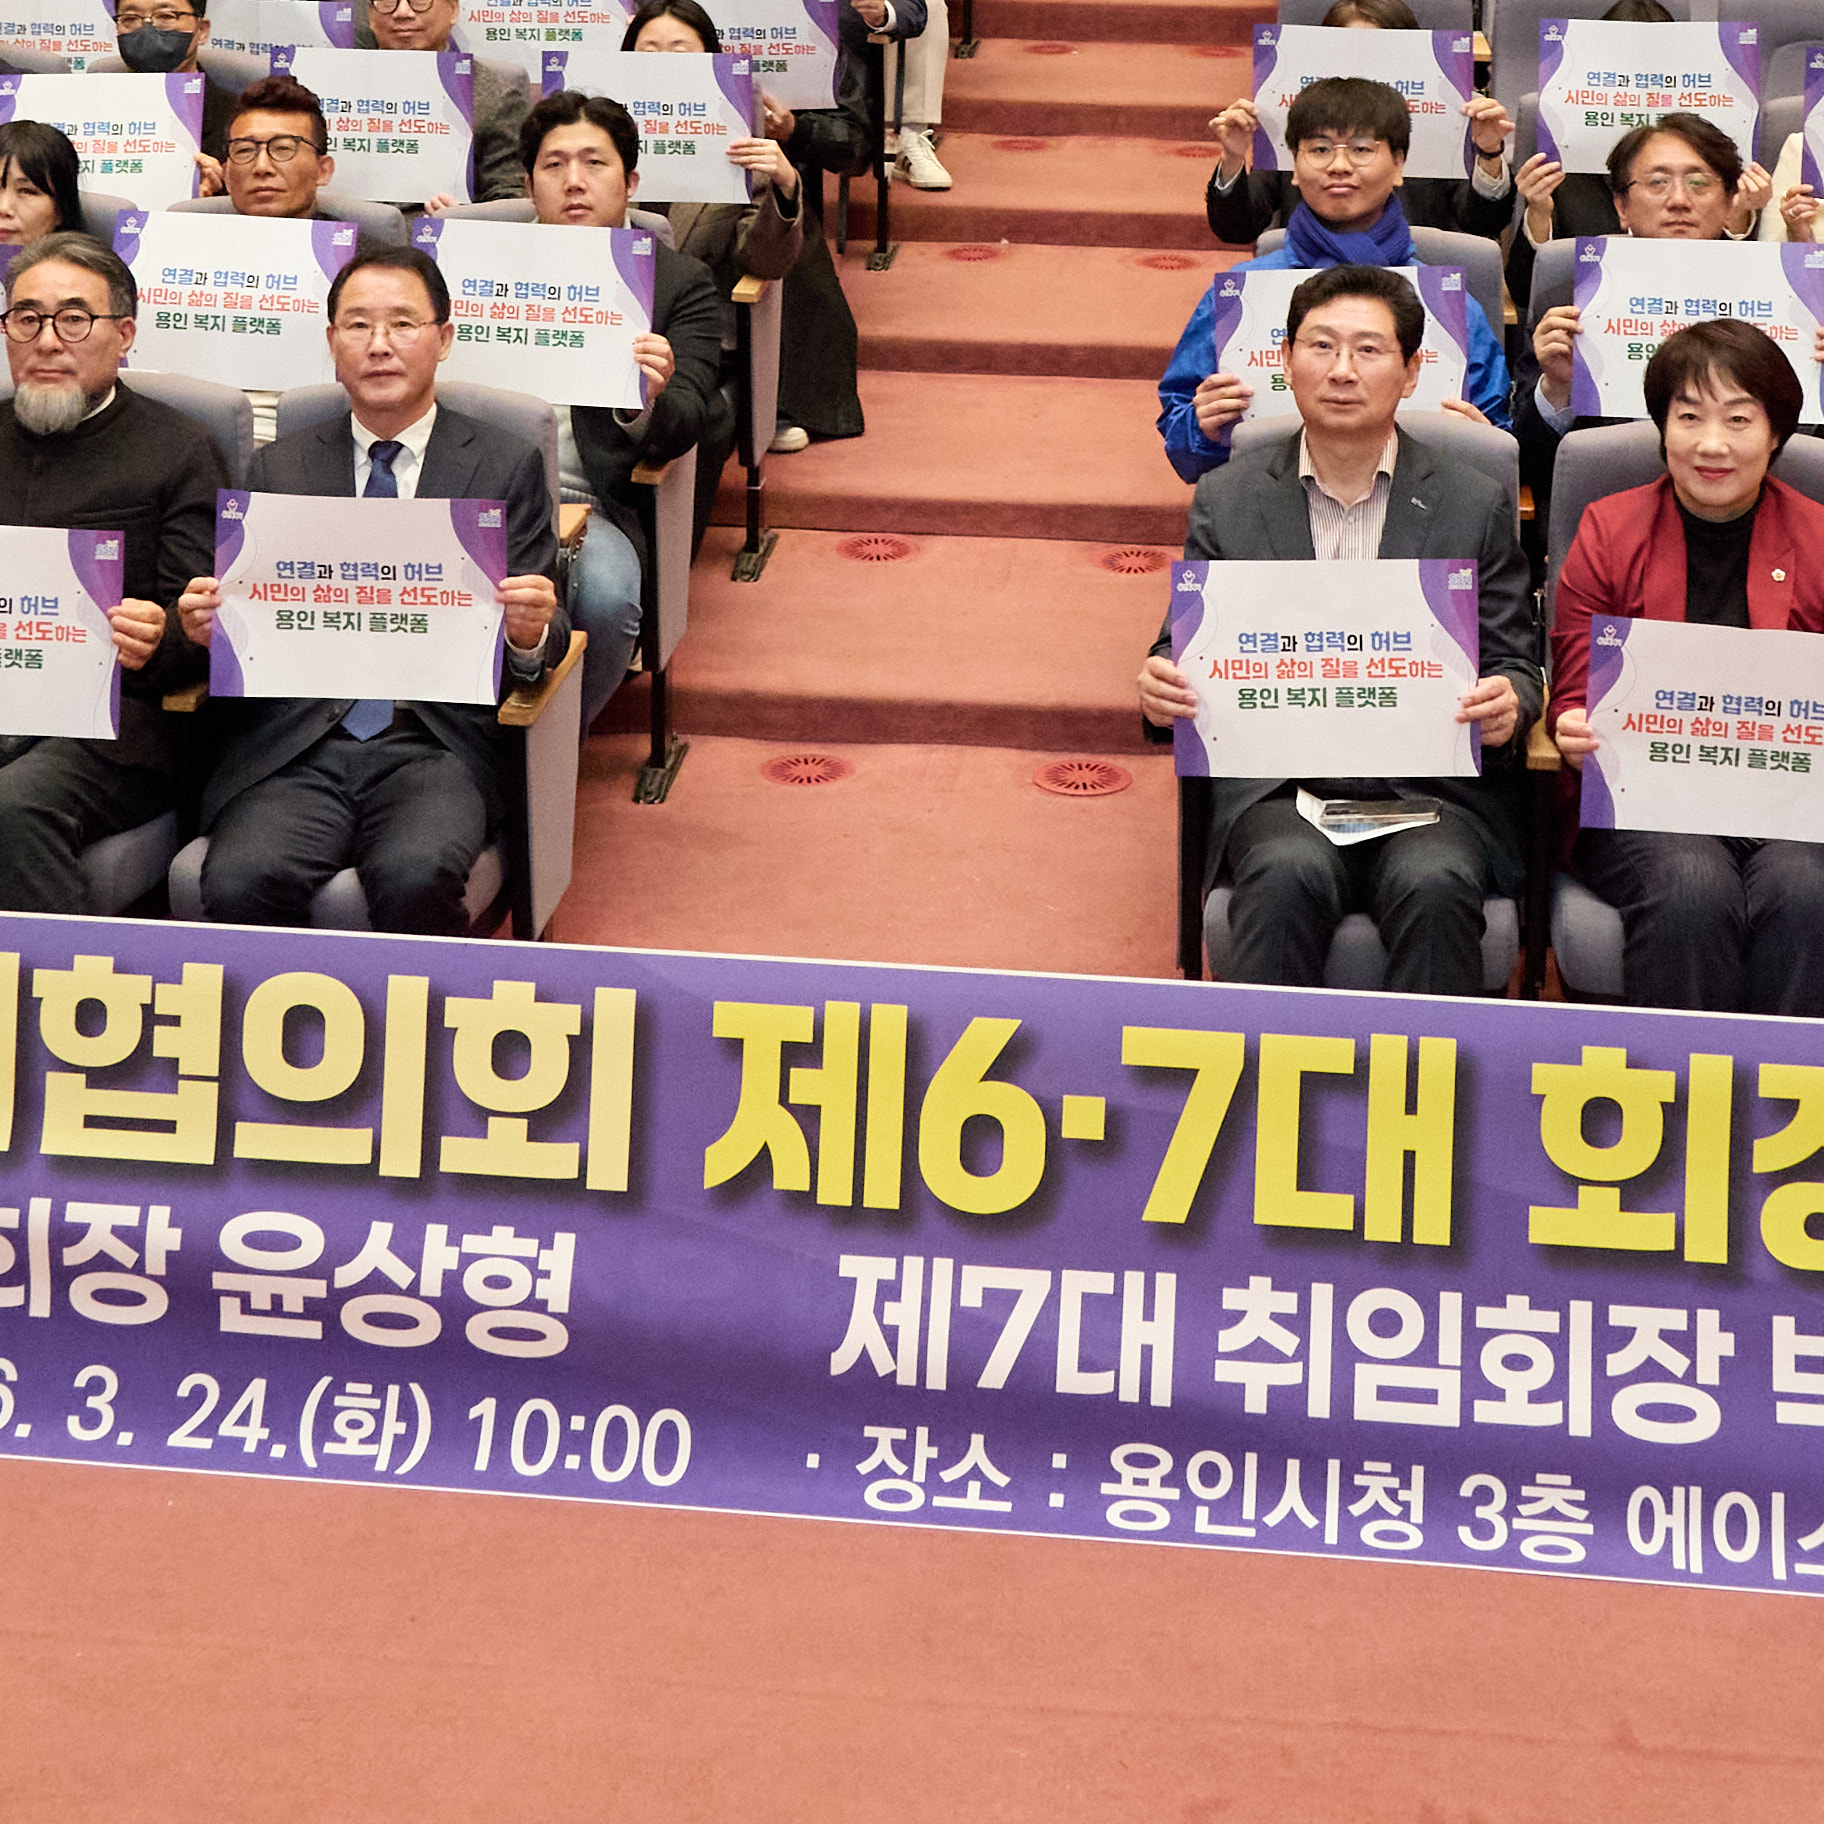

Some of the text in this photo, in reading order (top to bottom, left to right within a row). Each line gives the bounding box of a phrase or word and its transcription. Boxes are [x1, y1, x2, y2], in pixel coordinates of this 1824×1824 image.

[468, 9, 610, 24] 시민의 삶의 질을 선도하는
[485, 28, 582, 41] 용인 복지 플랫폼
[276, 559, 443, 582] 연결과 협력의 허브
[249, 583, 473, 608] 시민의 삶의 질을 선도하는
[276, 610, 429, 633] 용인 복지 플랫폼
[1238, 632, 1412, 654] 연결과 협력의 허브
[1209, 658, 1443, 679] 시민의 삶의 질을 선도하는
[1238, 687, 1397, 709] 용인 복지 플랫폼
[704, 1001, 1456, 1246] 제6·7대
[213, 1211, 576, 1357] 윤상형
[831, 1255, 1176, 1407] 제7대
[1215, 1276, 1734, 1444] 취임회장
[67, 1365, 133, 1445] 3.
[167, 1374, 431, 1475] 24.(화)
[469, 1398, 691, 1486] 10:00
[856, 1426, 1012, 1512] 장소
[1101, 1444, 1424, 1550] 용인시청
[1458, 1474, 1593, 1563] 3층
